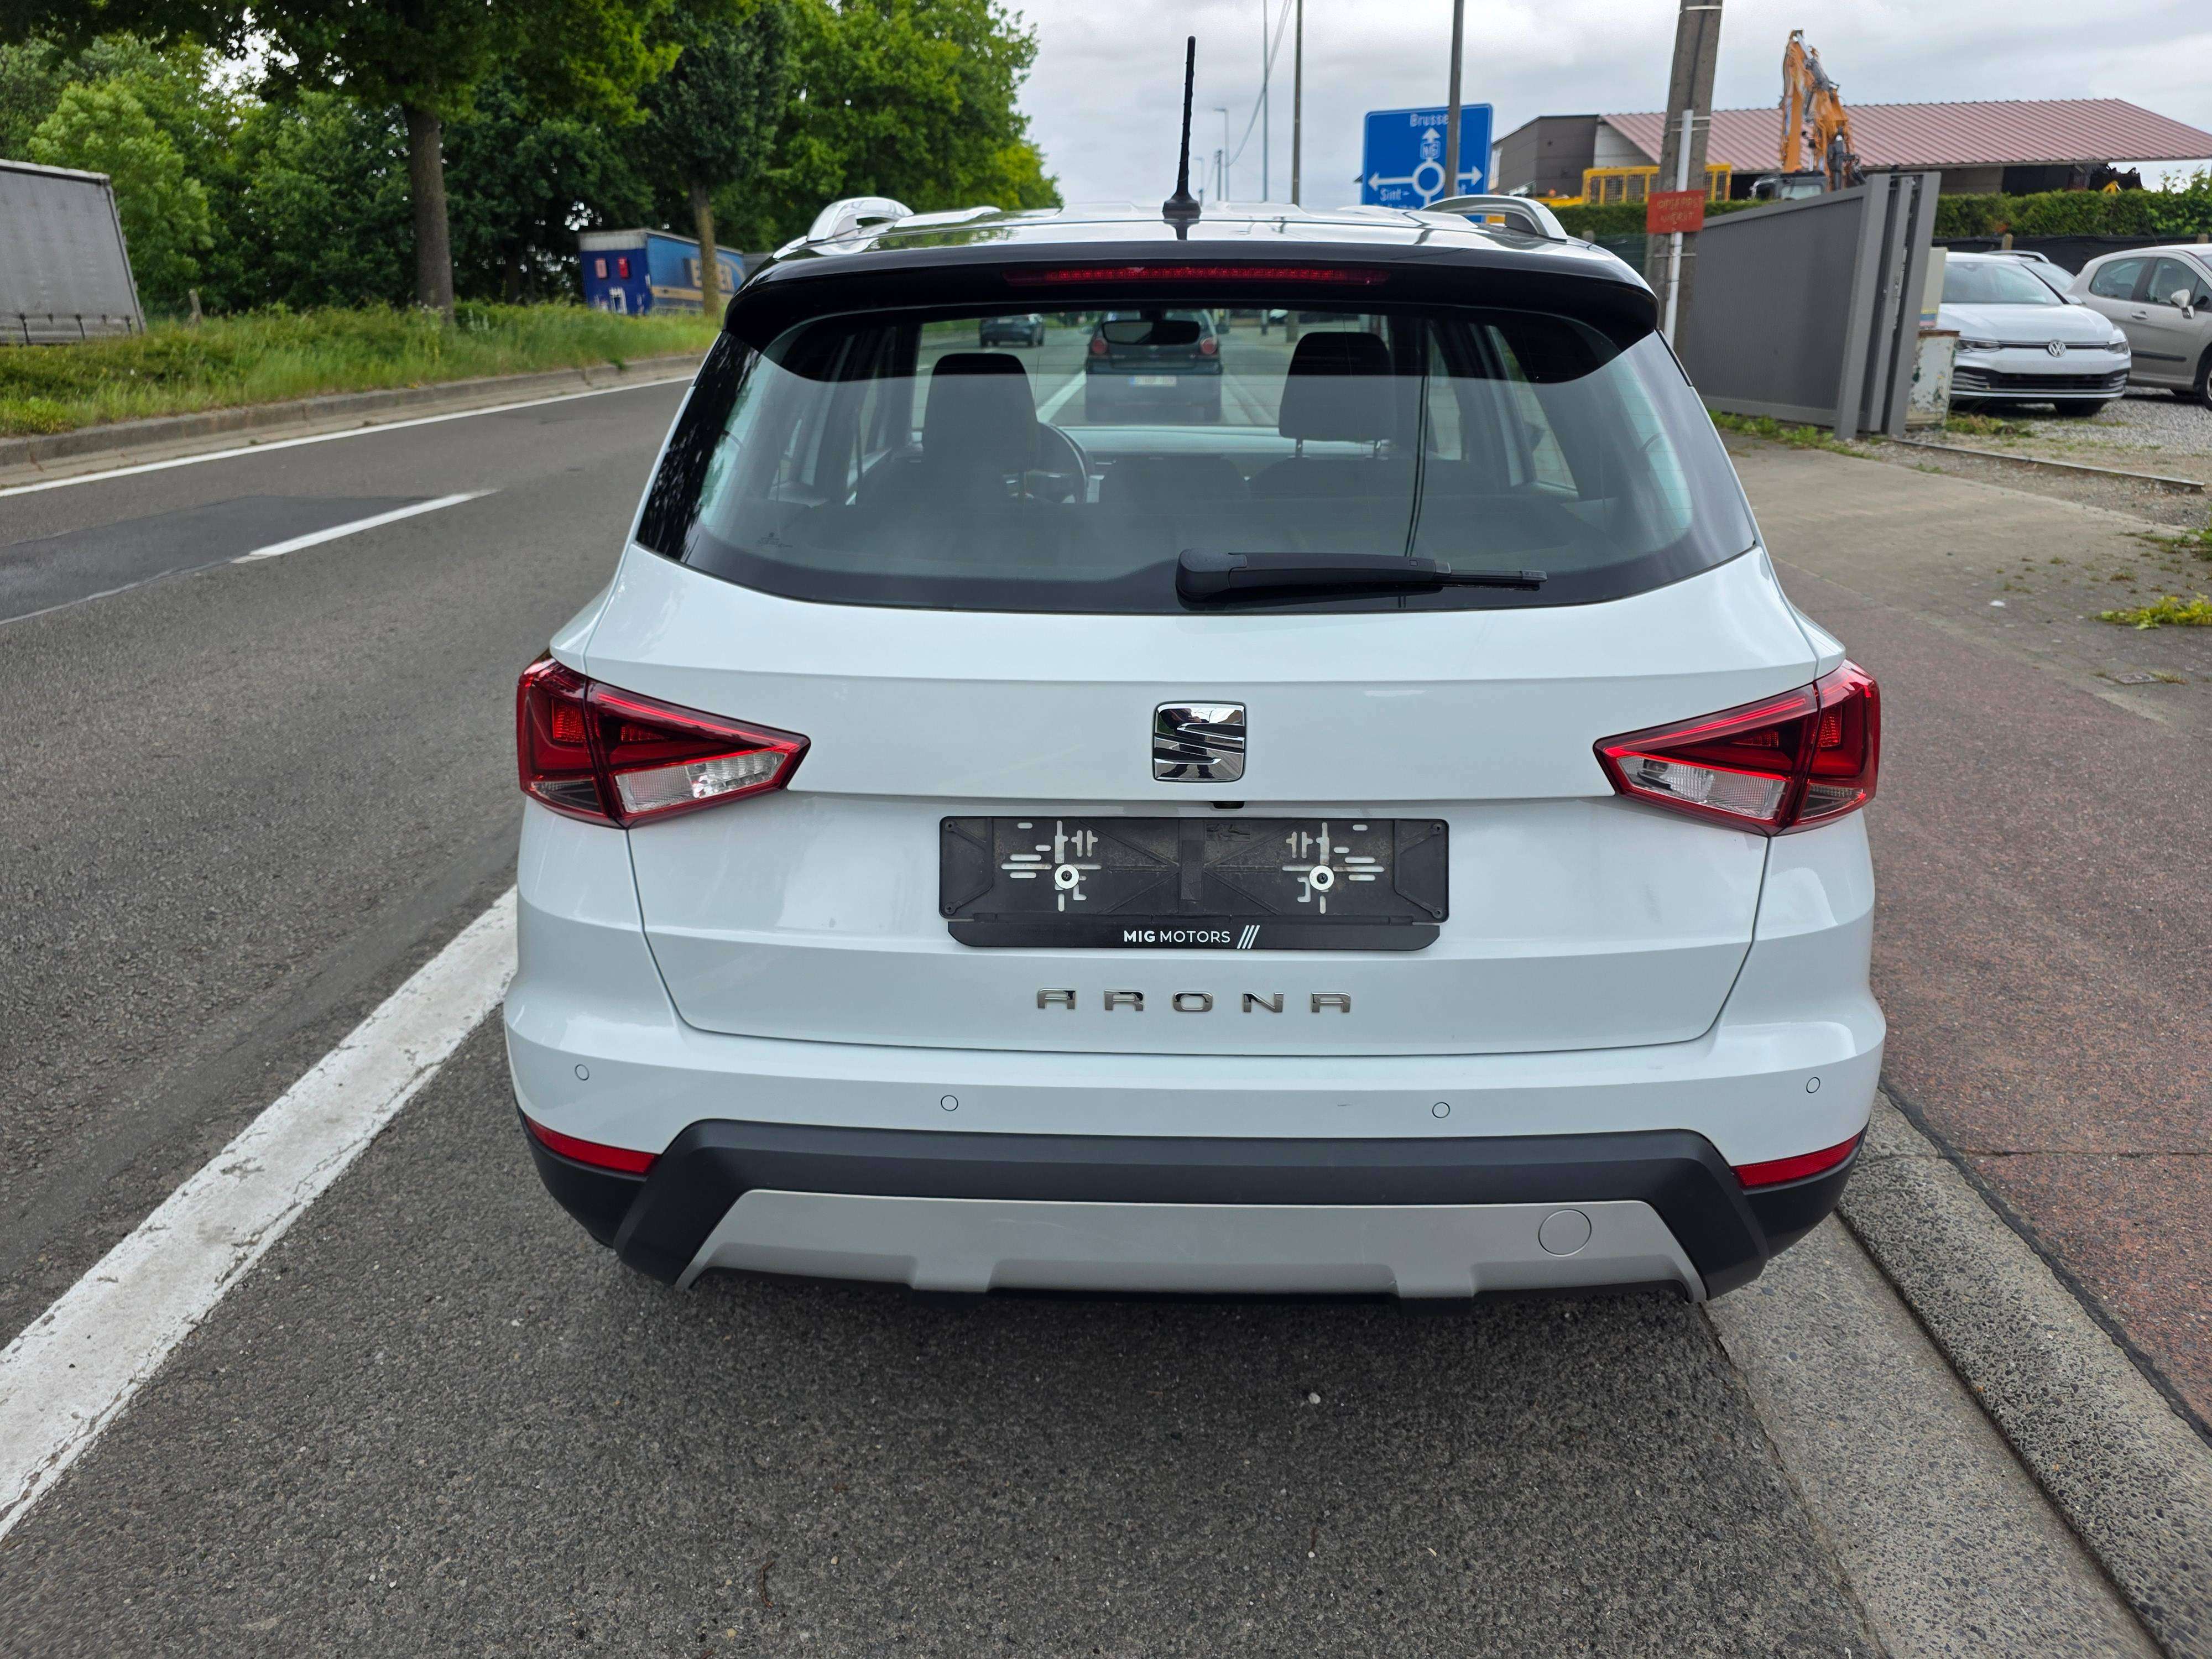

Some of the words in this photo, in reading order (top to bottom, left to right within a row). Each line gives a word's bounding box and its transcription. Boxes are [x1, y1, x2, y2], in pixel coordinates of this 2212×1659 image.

[1410, 113, 1449, 127] Brusse
[1124, 930, 1155, 942] MIG
[1160, 930, 1231, 943] MOTORS
[1037, 988, 1351, 1013] ARONA
